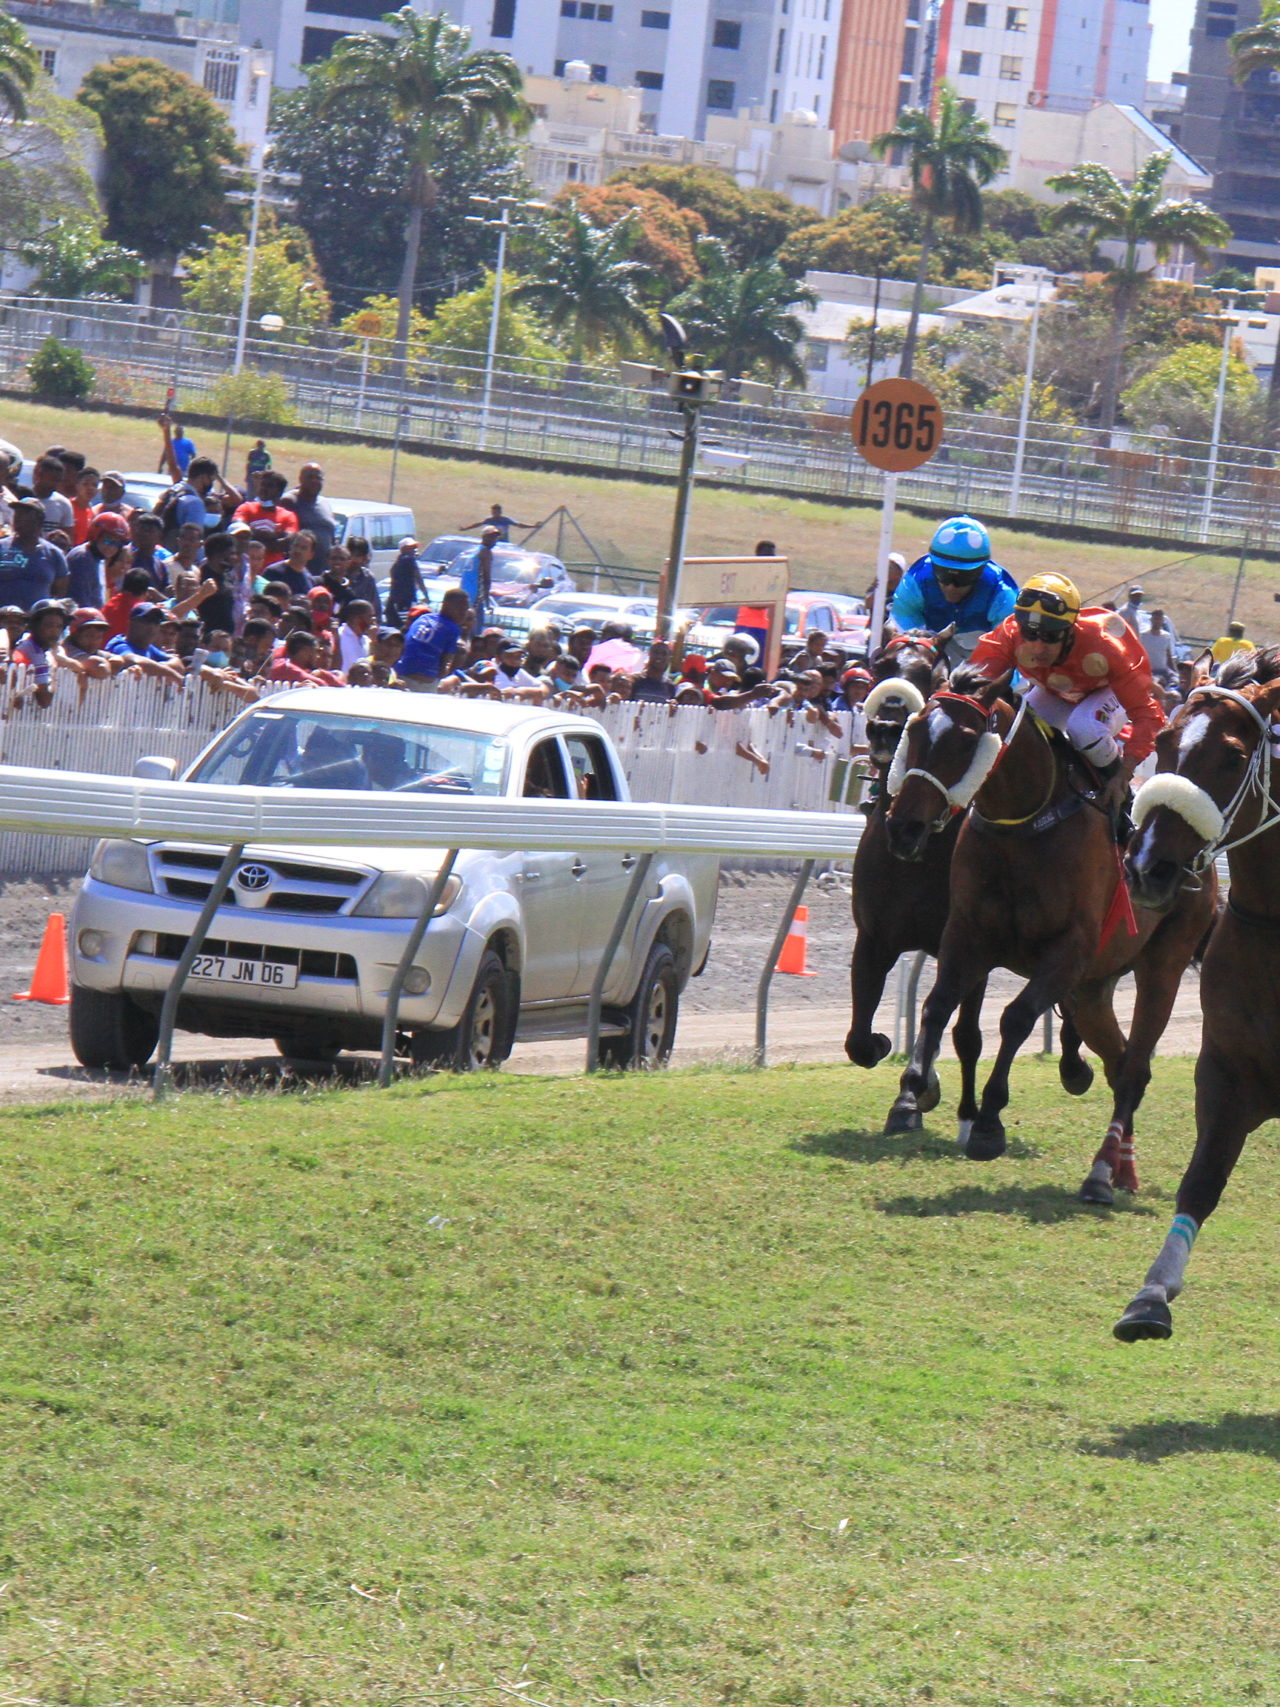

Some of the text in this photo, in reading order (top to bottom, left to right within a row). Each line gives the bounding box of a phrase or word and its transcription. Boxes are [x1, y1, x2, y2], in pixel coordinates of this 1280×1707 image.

[859, 399, 937, 452] 1365
[190, 957, 284, 985] 227 JN 06
